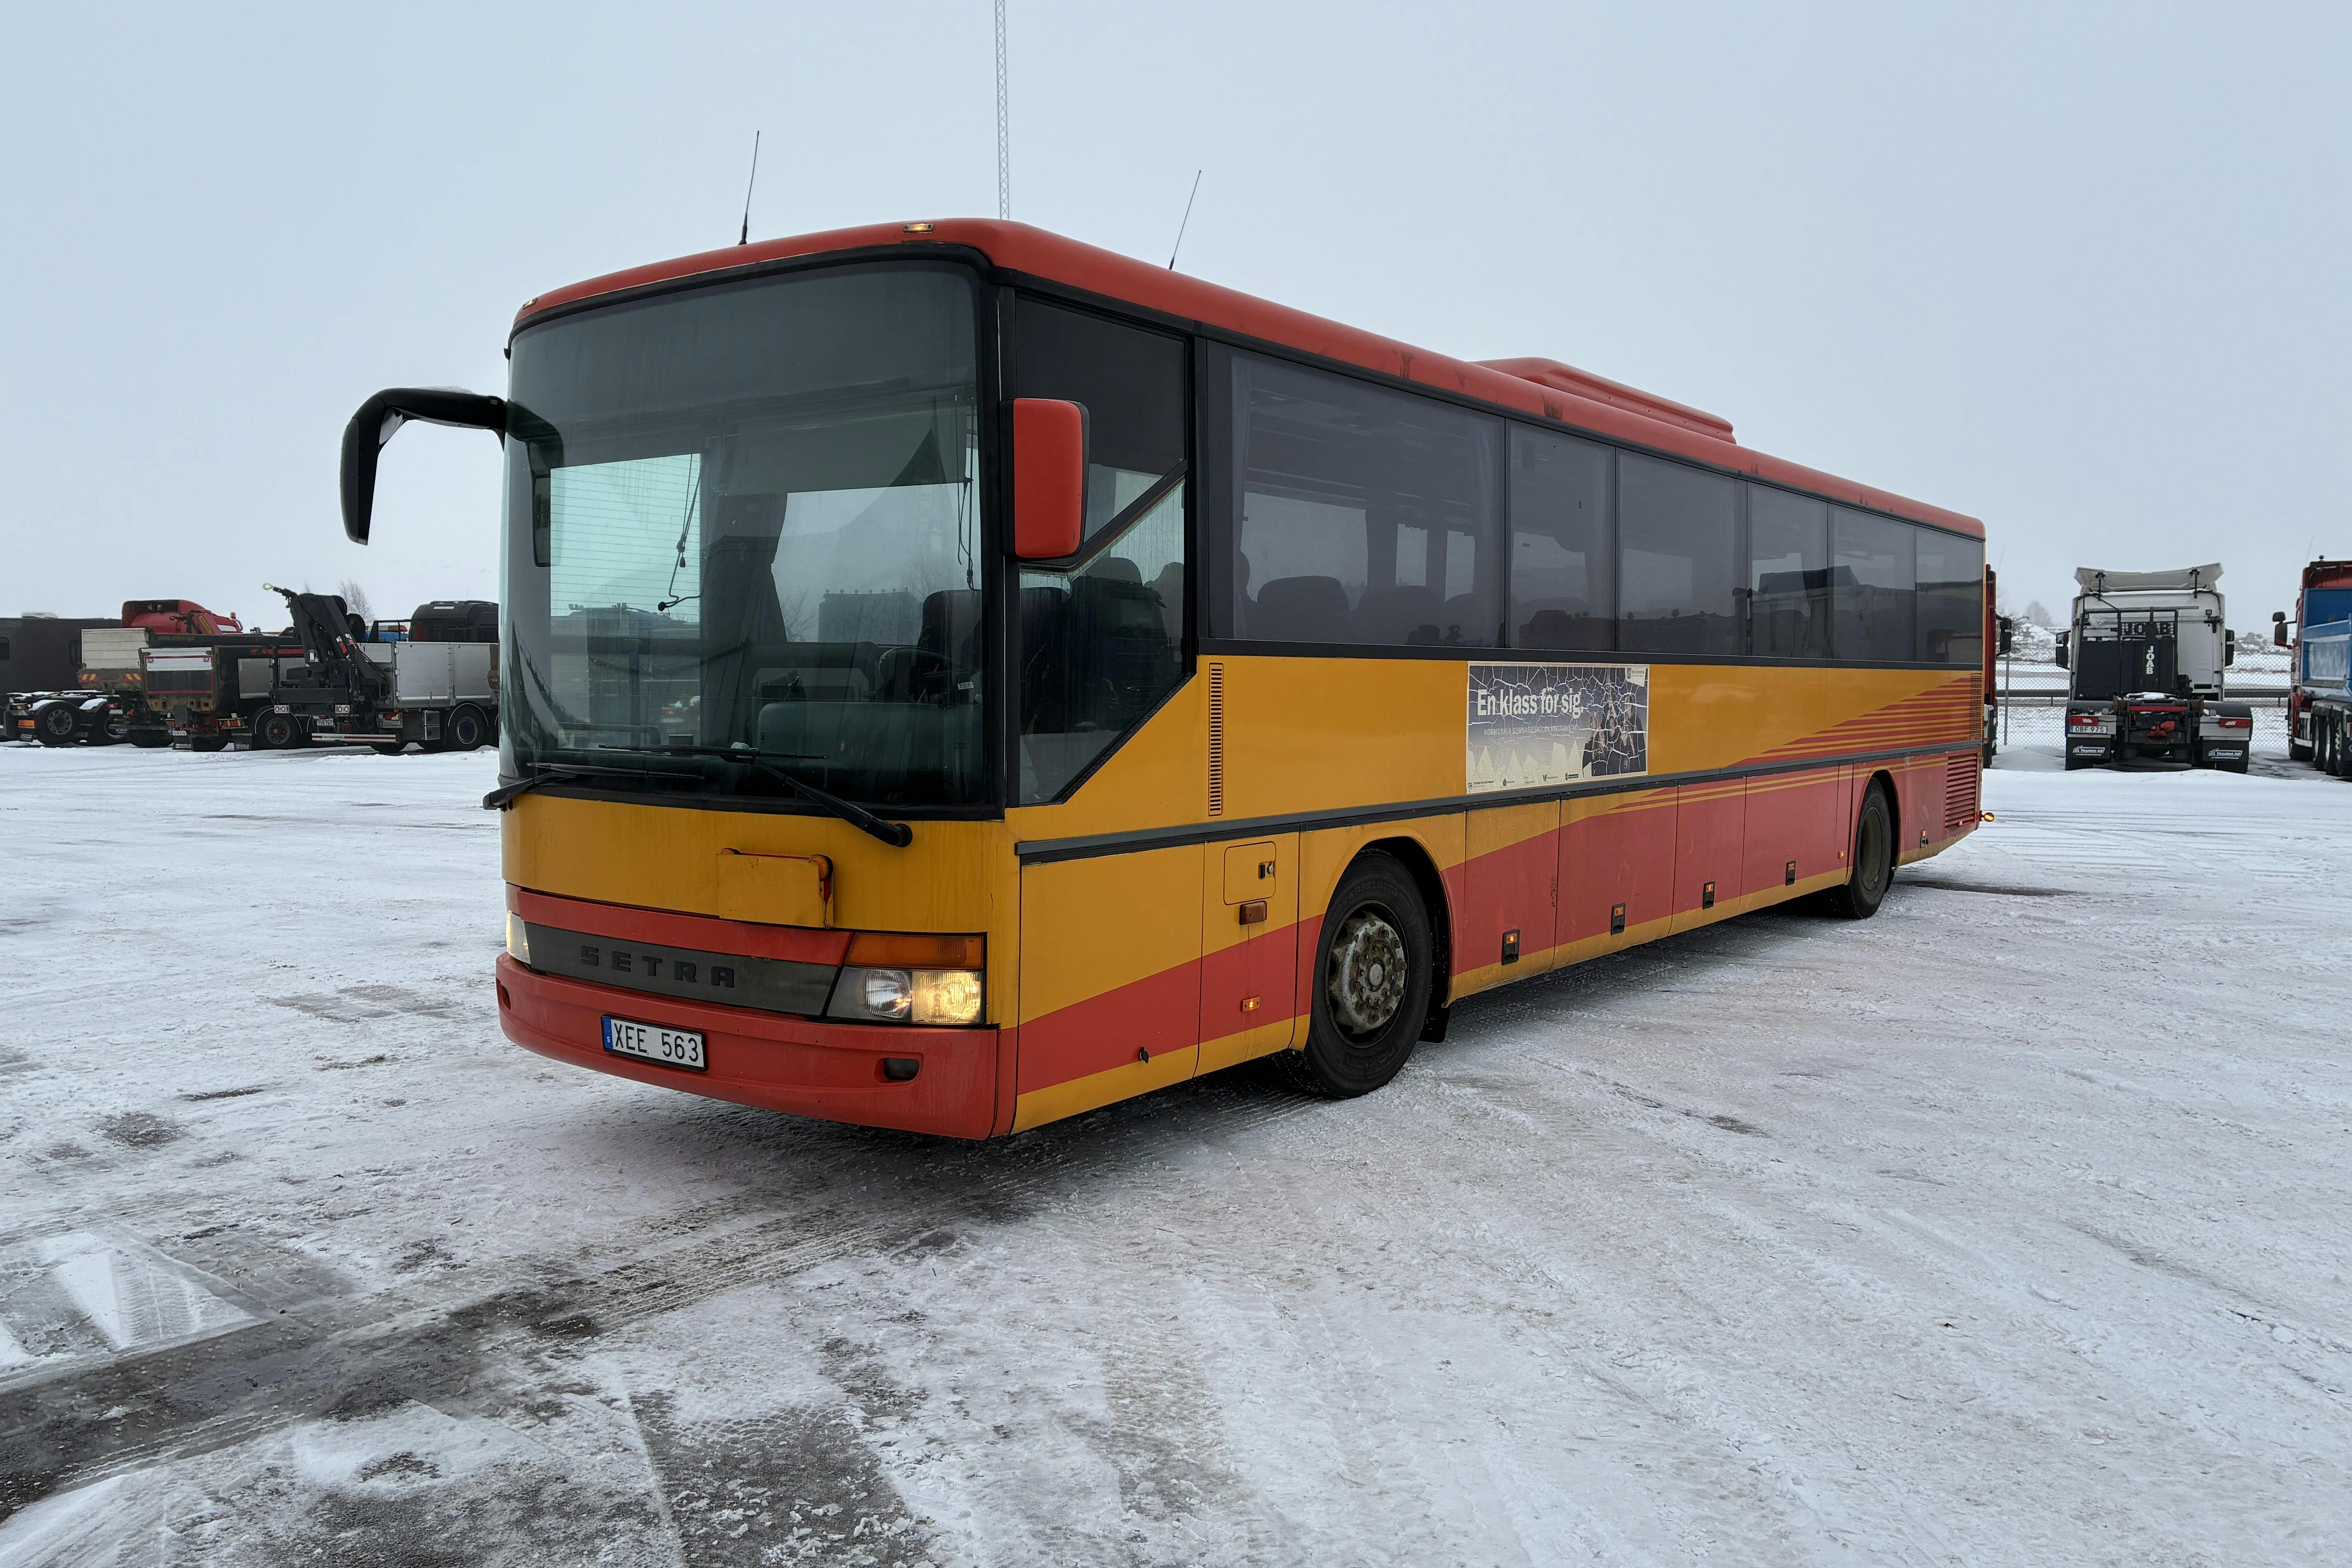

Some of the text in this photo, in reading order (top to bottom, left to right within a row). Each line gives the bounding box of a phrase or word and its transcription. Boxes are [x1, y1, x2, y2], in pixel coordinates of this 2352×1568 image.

[2124, 622, 2171, 635] JOB
[2146, 646, 2155, 674] JOAB
[1477, 689, 1496, 716] En
[1500, 689, 1538, 715] klass
[1541, 687, 1559, 714] för
[581, 946, 735, 988] SETRA
[614, 1023, 647, 1053] XEE
[661, 1032, 698, 1062] 563
